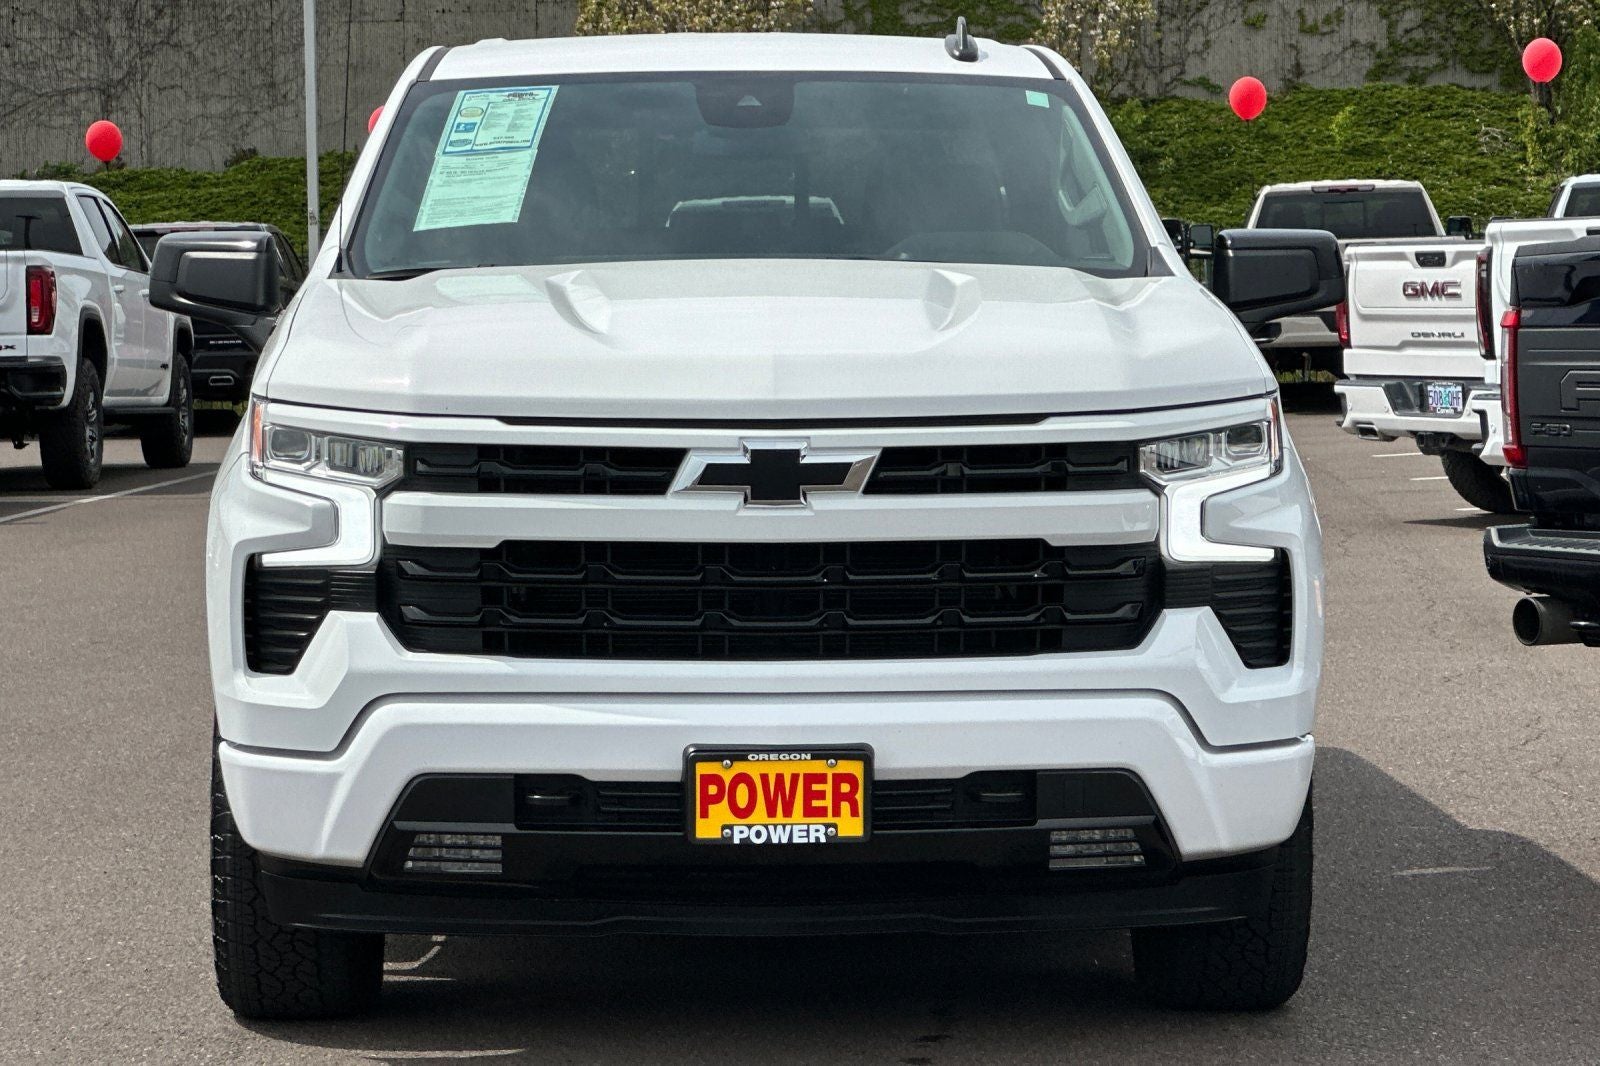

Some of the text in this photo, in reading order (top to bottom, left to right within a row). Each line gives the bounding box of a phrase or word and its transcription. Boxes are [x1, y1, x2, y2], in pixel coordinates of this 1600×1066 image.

[1402, 281, 1462, 299] GMC
[747, 753, 812, 761] OREGON
[699, 771, 860, 819] POWER
[733, 824, 827, 844] POWER
